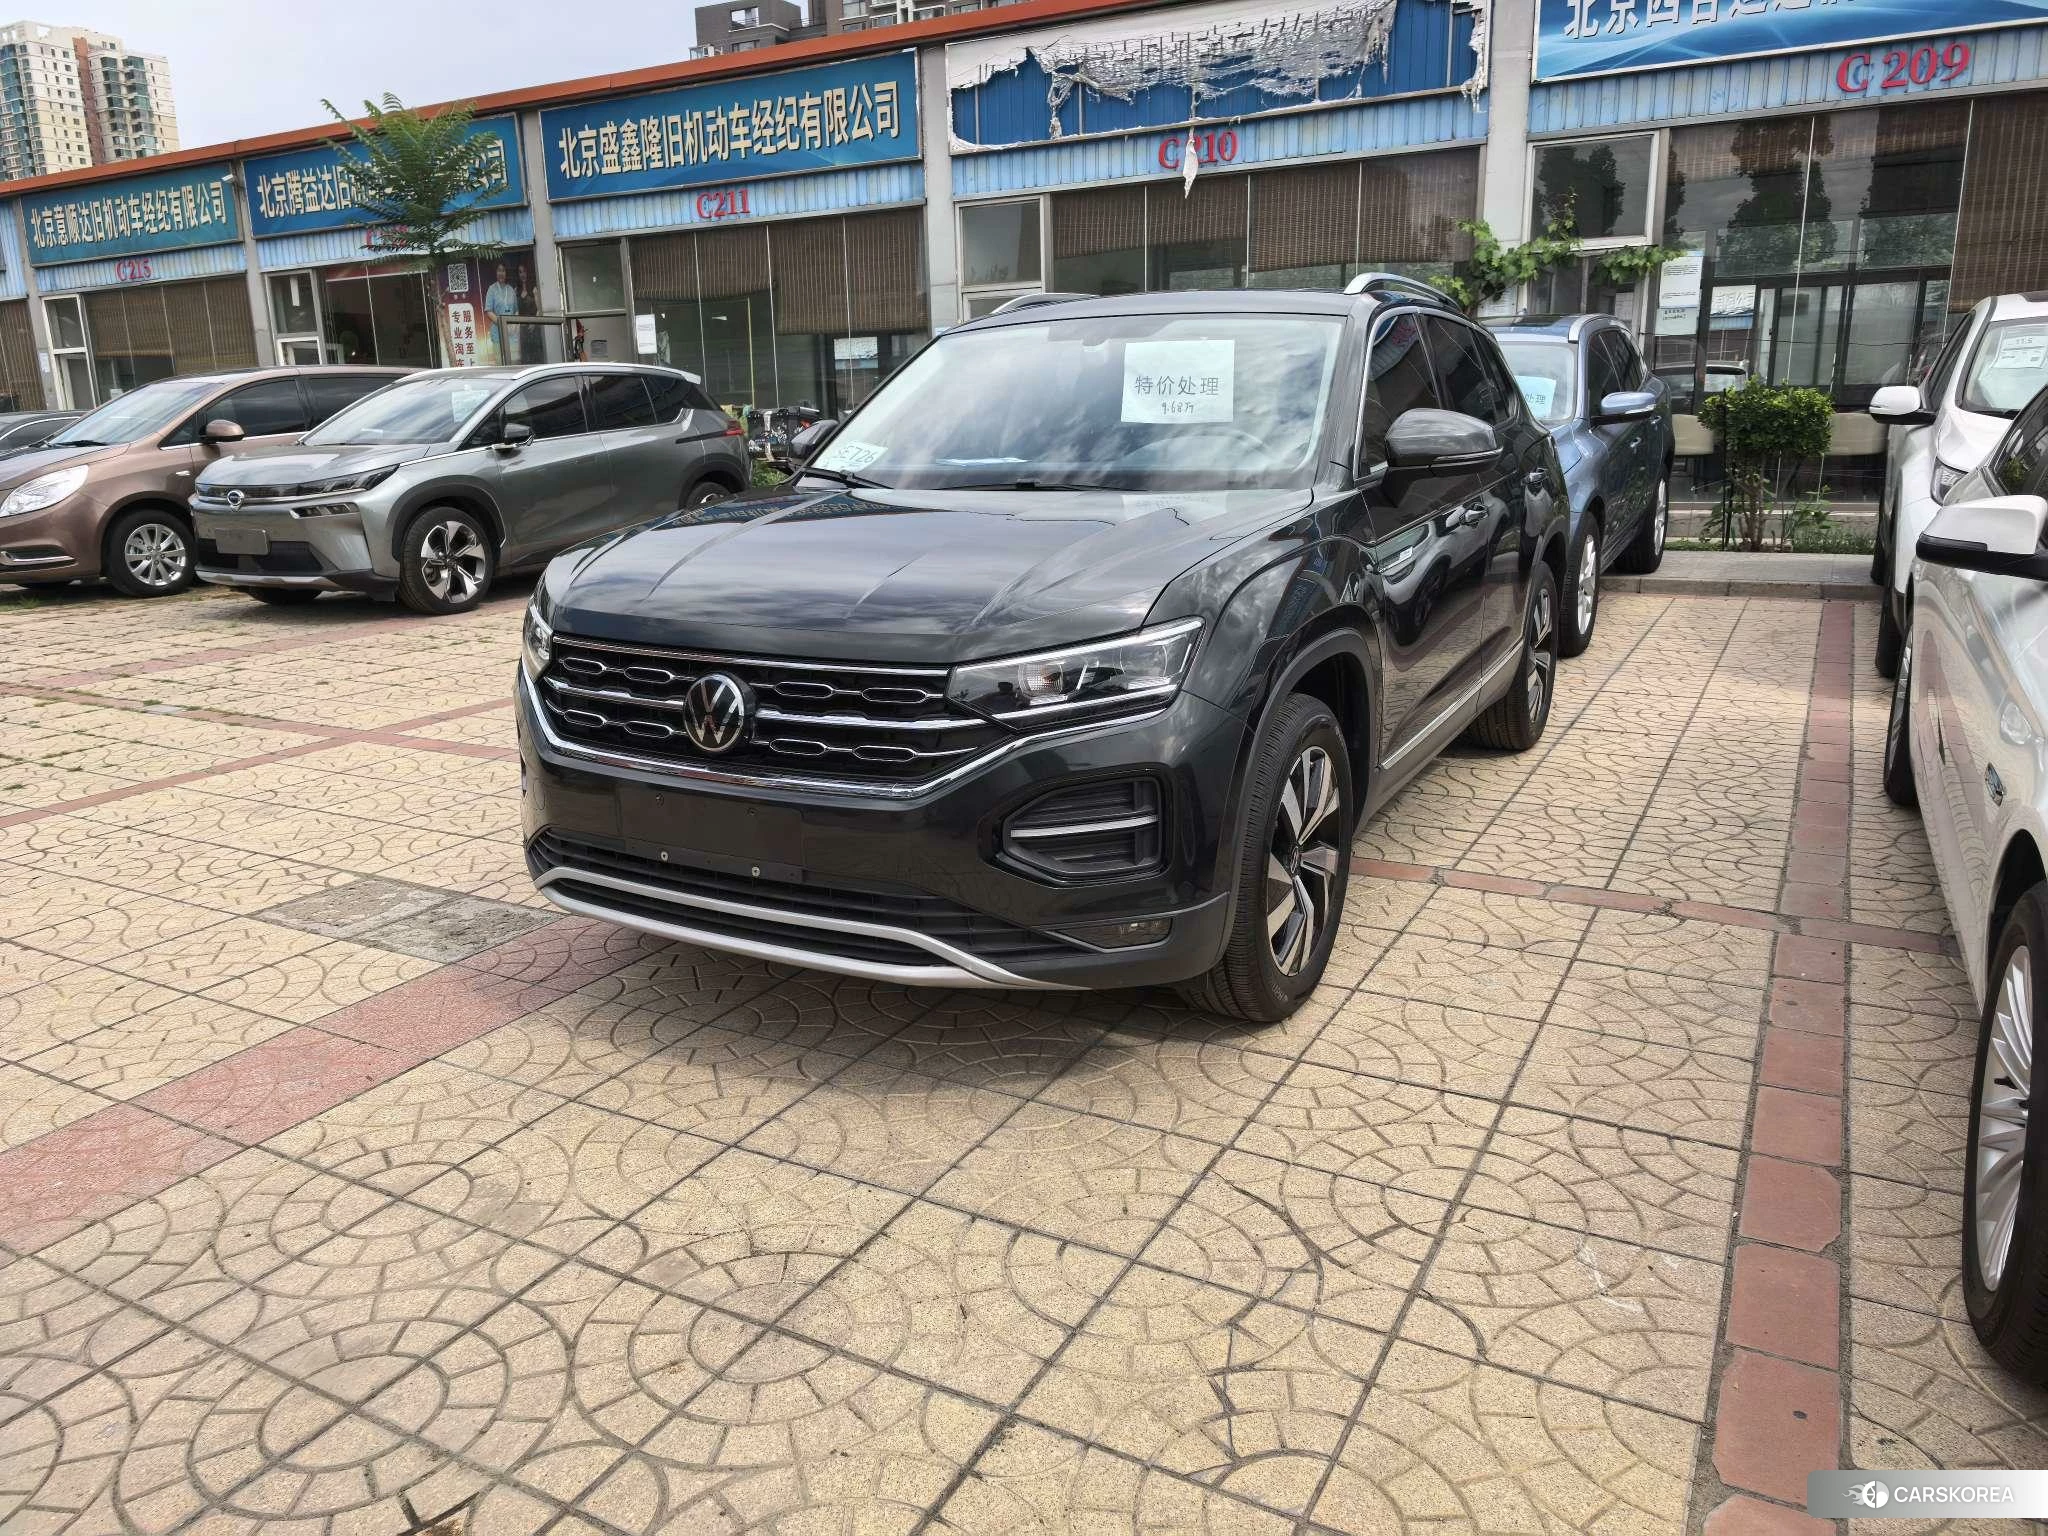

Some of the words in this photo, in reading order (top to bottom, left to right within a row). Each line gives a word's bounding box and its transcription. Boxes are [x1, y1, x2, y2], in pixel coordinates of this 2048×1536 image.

[558, 80, 900, 180] 北京盛鑫隆旧机动车经纪有限公司
[695, 188, 751, 219] C211
[115, 257, 153, 282] C215
[1135, 375, 1220, 396] 特价处理
